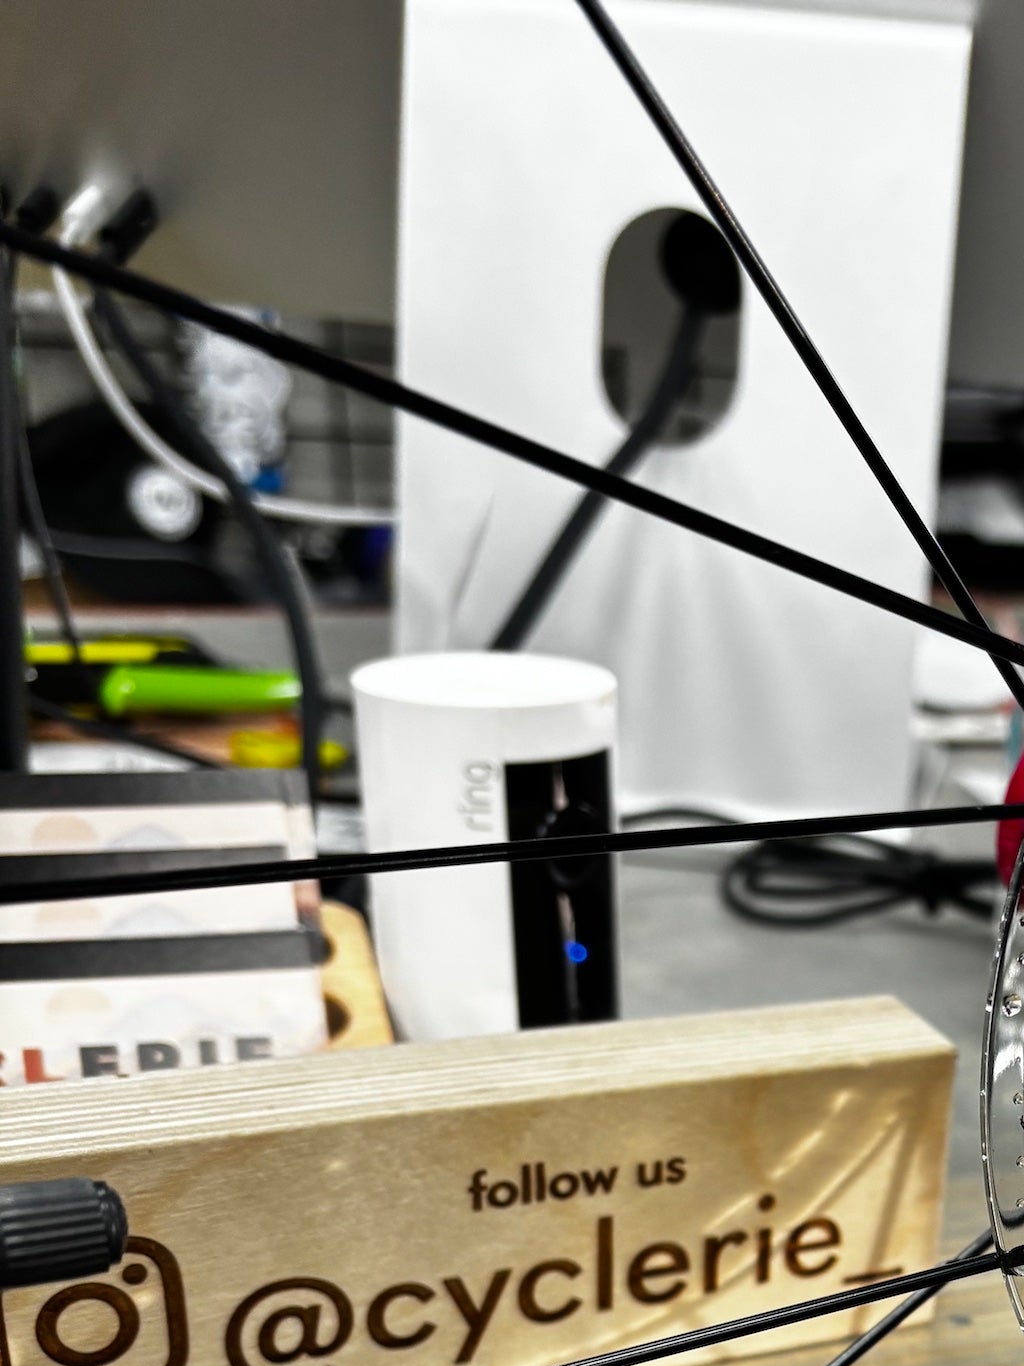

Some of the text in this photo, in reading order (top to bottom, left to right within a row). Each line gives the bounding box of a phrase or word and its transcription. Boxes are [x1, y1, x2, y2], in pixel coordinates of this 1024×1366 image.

[456, 761, 502, 832] ring
[468, 1155, 688, 1212] follow us
